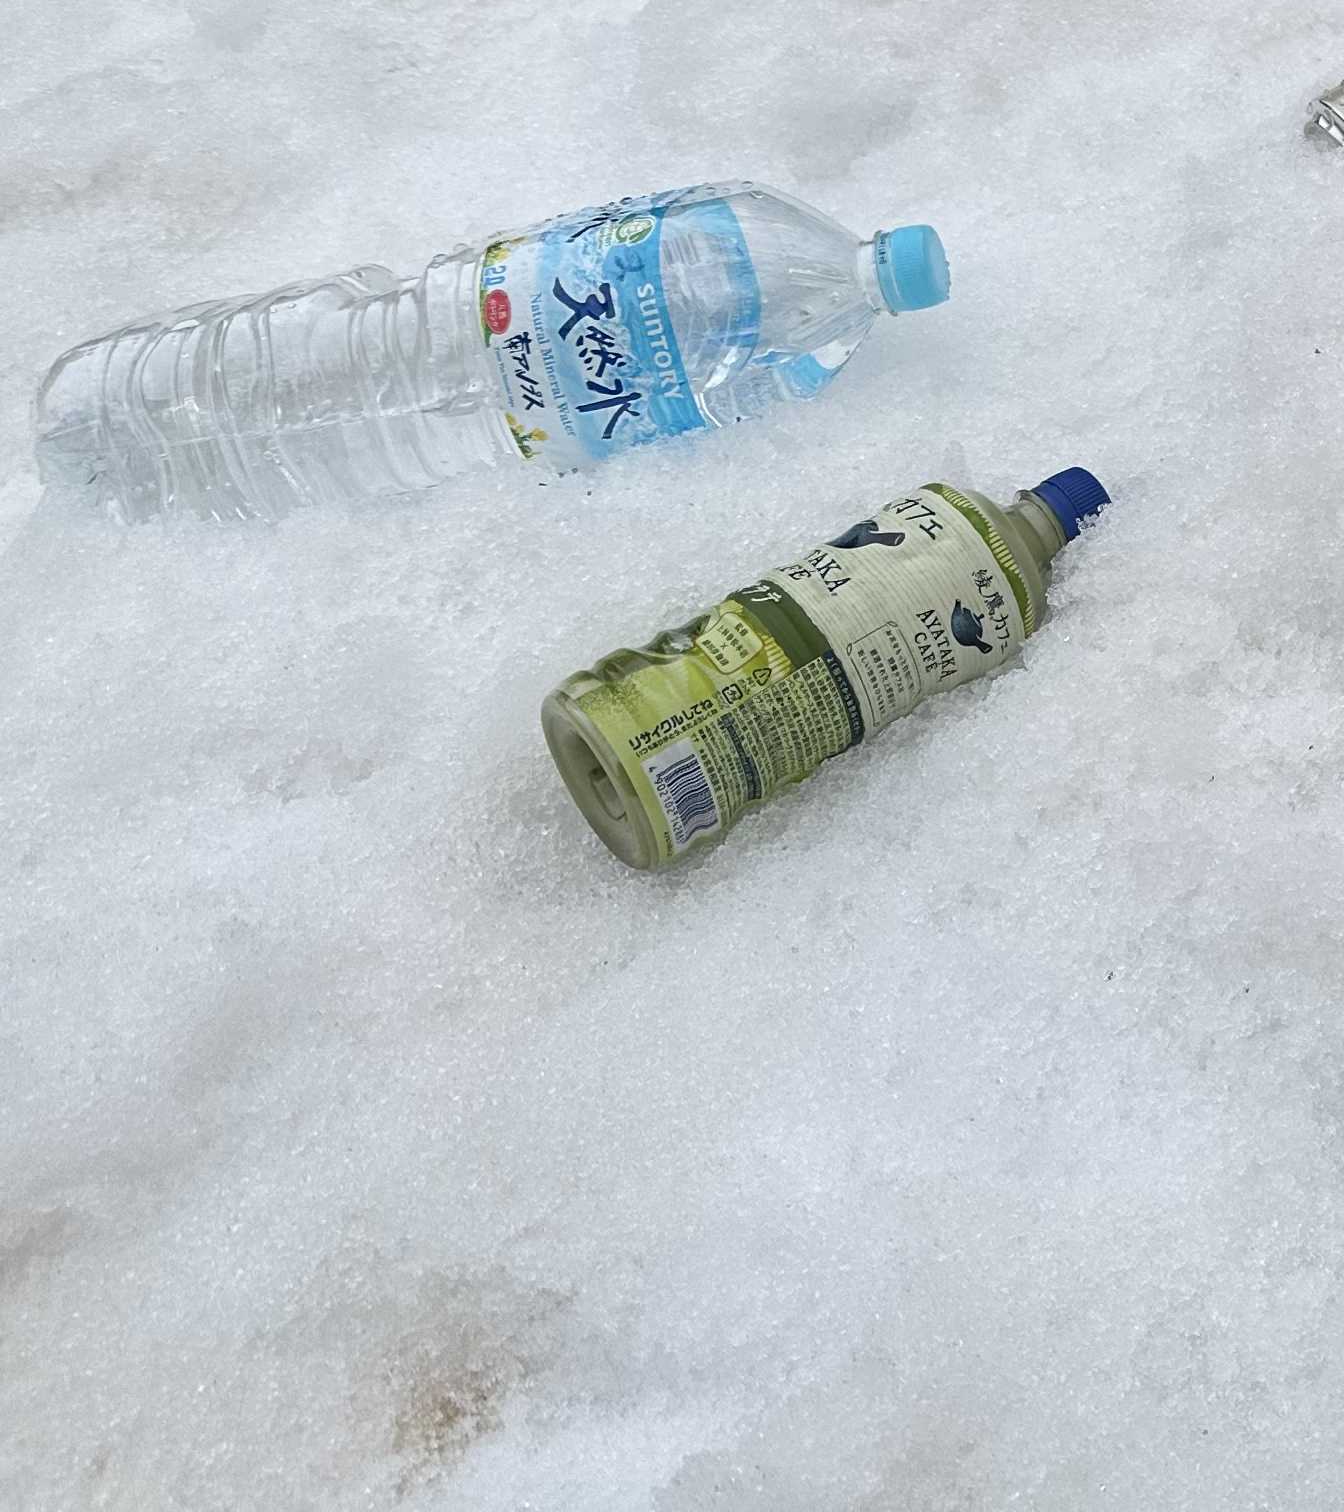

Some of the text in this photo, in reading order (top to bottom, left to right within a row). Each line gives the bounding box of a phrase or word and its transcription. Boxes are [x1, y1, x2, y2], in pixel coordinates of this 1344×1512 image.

[502, 331, 545, 411] 南アルプス
[531, 292, 578, 437] Natural Mineral Water
[553, 276, 641, 439] 天然水
[637, 282, 685, 399] SUNTORY
[916, 608, 958, 683] AYATAKA
